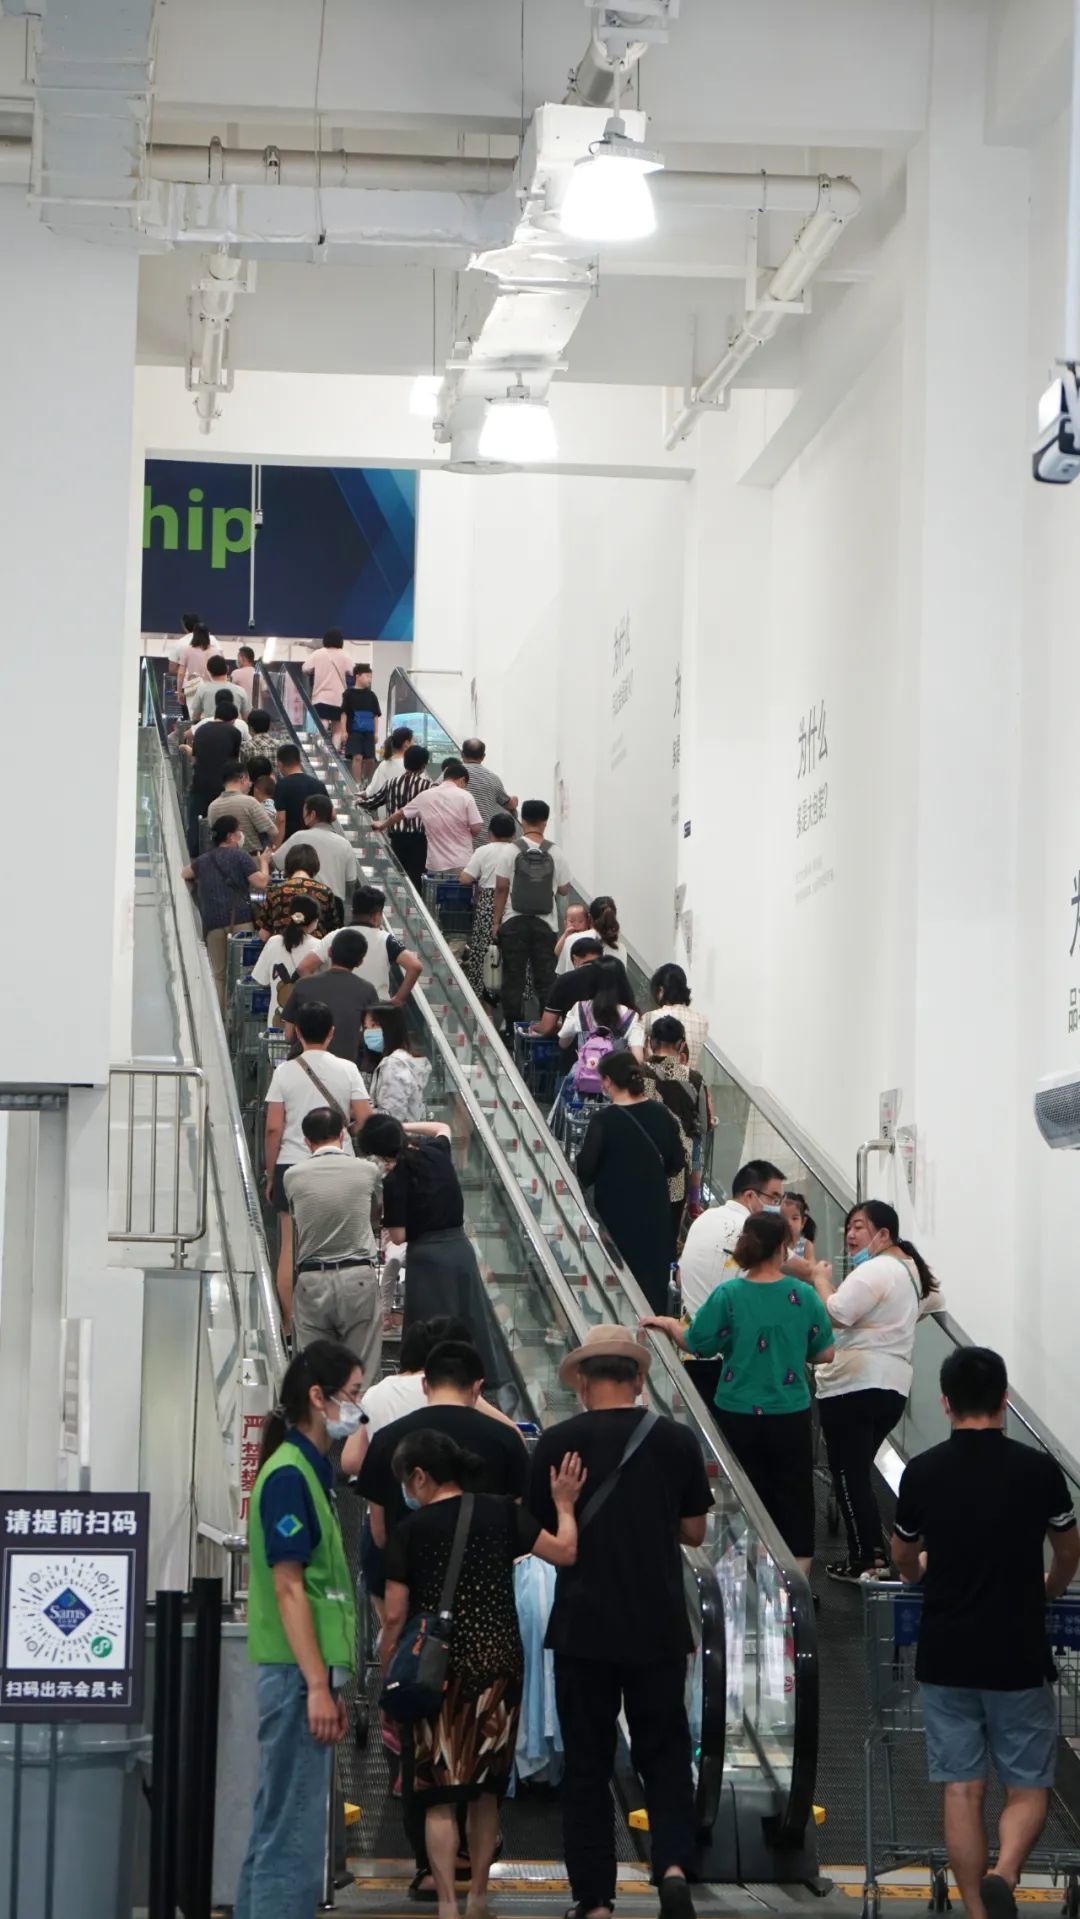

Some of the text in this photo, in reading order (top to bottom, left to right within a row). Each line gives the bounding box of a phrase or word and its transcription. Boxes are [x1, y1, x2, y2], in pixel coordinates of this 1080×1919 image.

[798, 699, 828, 779] 为什么
[5, 1508, 138, 1536] 请提前扫码
[6, 1680, 124, 1699] 扫码出示会员卡
